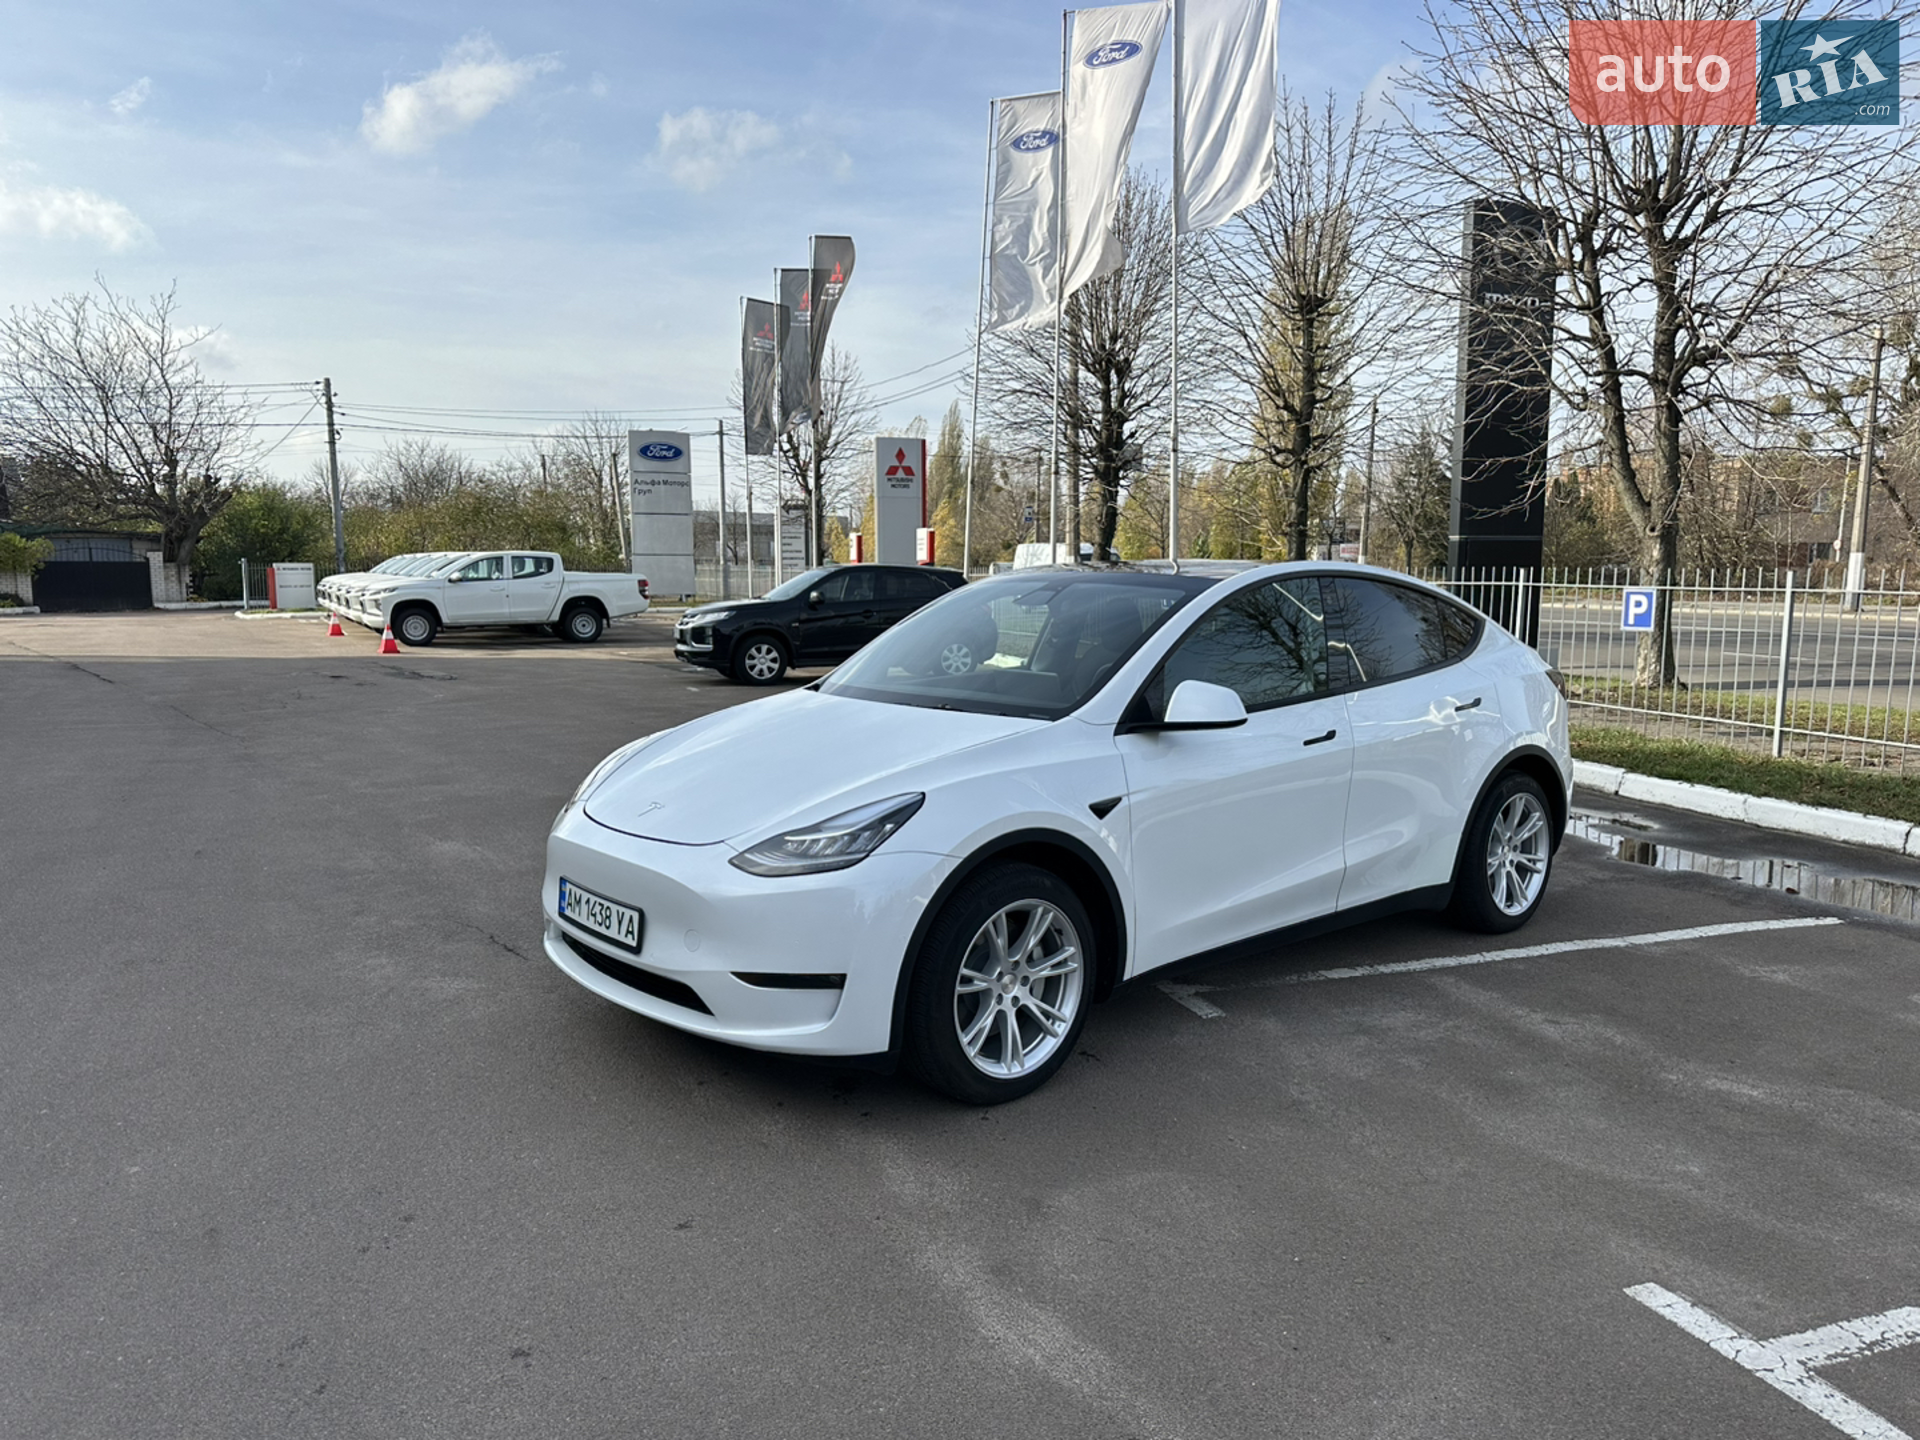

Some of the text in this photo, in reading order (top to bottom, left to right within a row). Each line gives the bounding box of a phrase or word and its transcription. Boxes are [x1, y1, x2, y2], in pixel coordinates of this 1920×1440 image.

[1093, 44, 1130, 65] Ford
[1020, 132, 1049, 149] Ford
[647, 445, 675, 457] Ford
[633, 478, 661, 487] Альфа
[633, 487, 652, 496] Груп
[1627, 594, 1649, 625] P
[567, 888, 636, 941] AM 1438 YA
